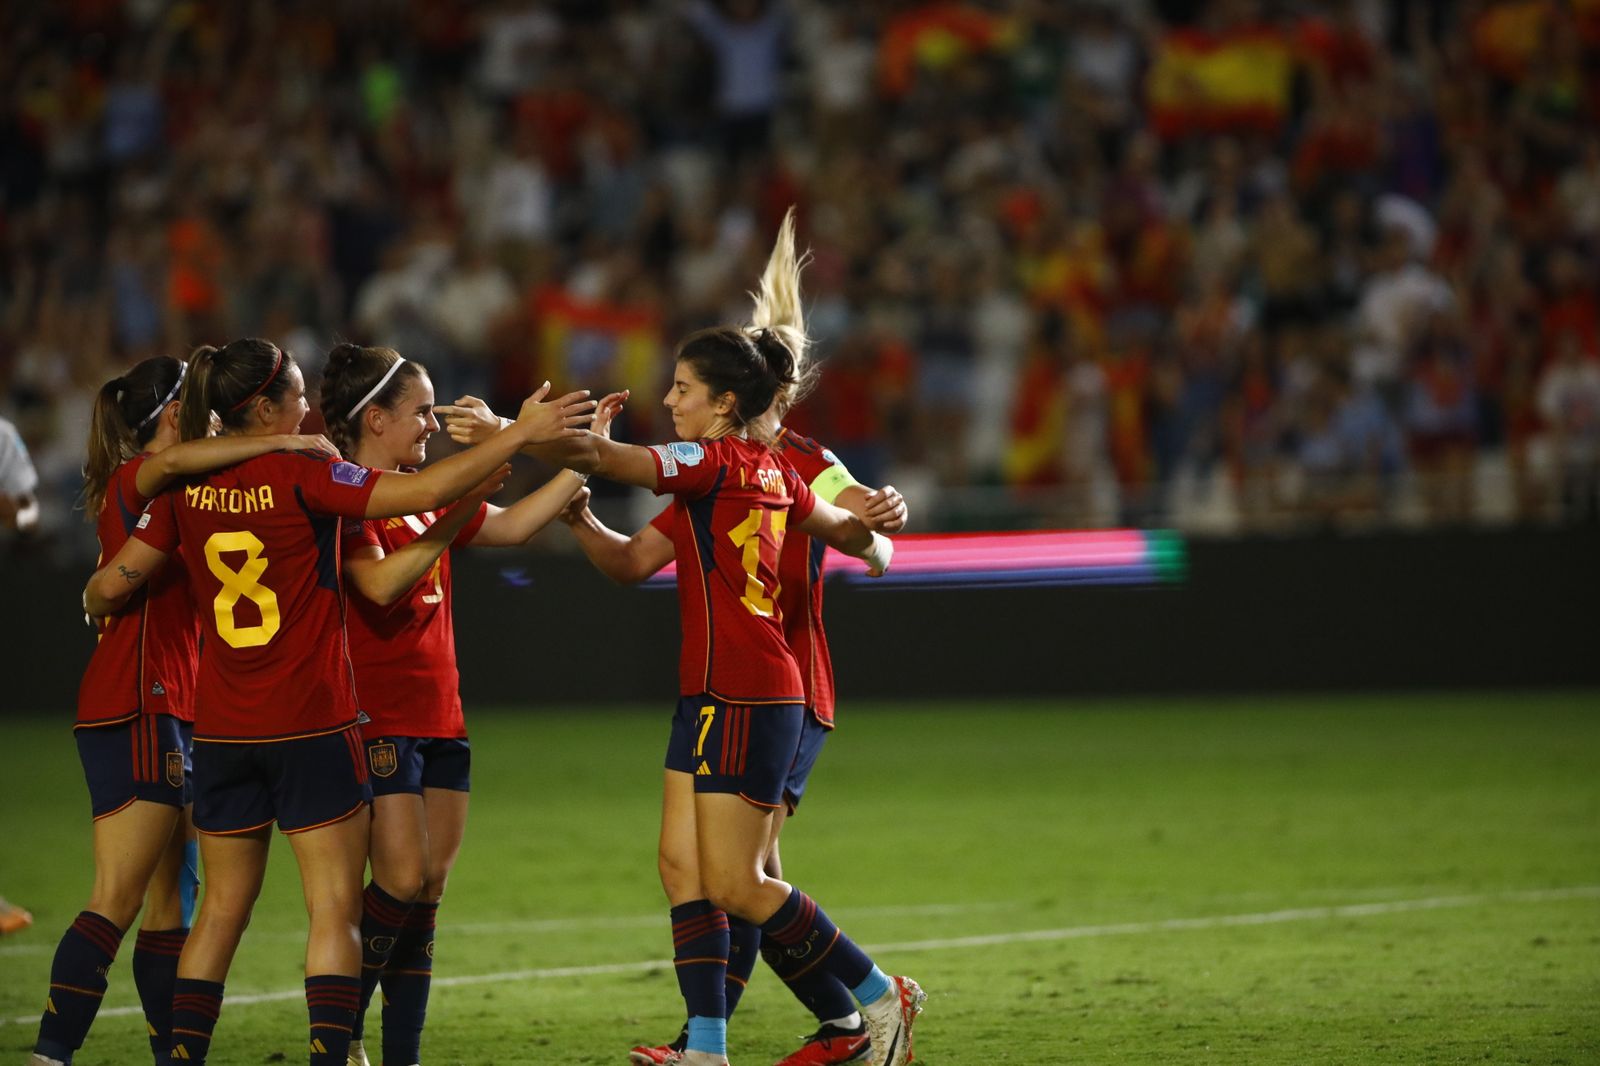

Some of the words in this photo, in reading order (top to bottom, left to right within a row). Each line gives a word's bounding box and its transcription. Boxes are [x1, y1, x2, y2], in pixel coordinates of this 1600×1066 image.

[757, 468, 788, 498] GAR
[185, 484, 275, 514] MARIONA
[204, 530, 281, 649] 8
